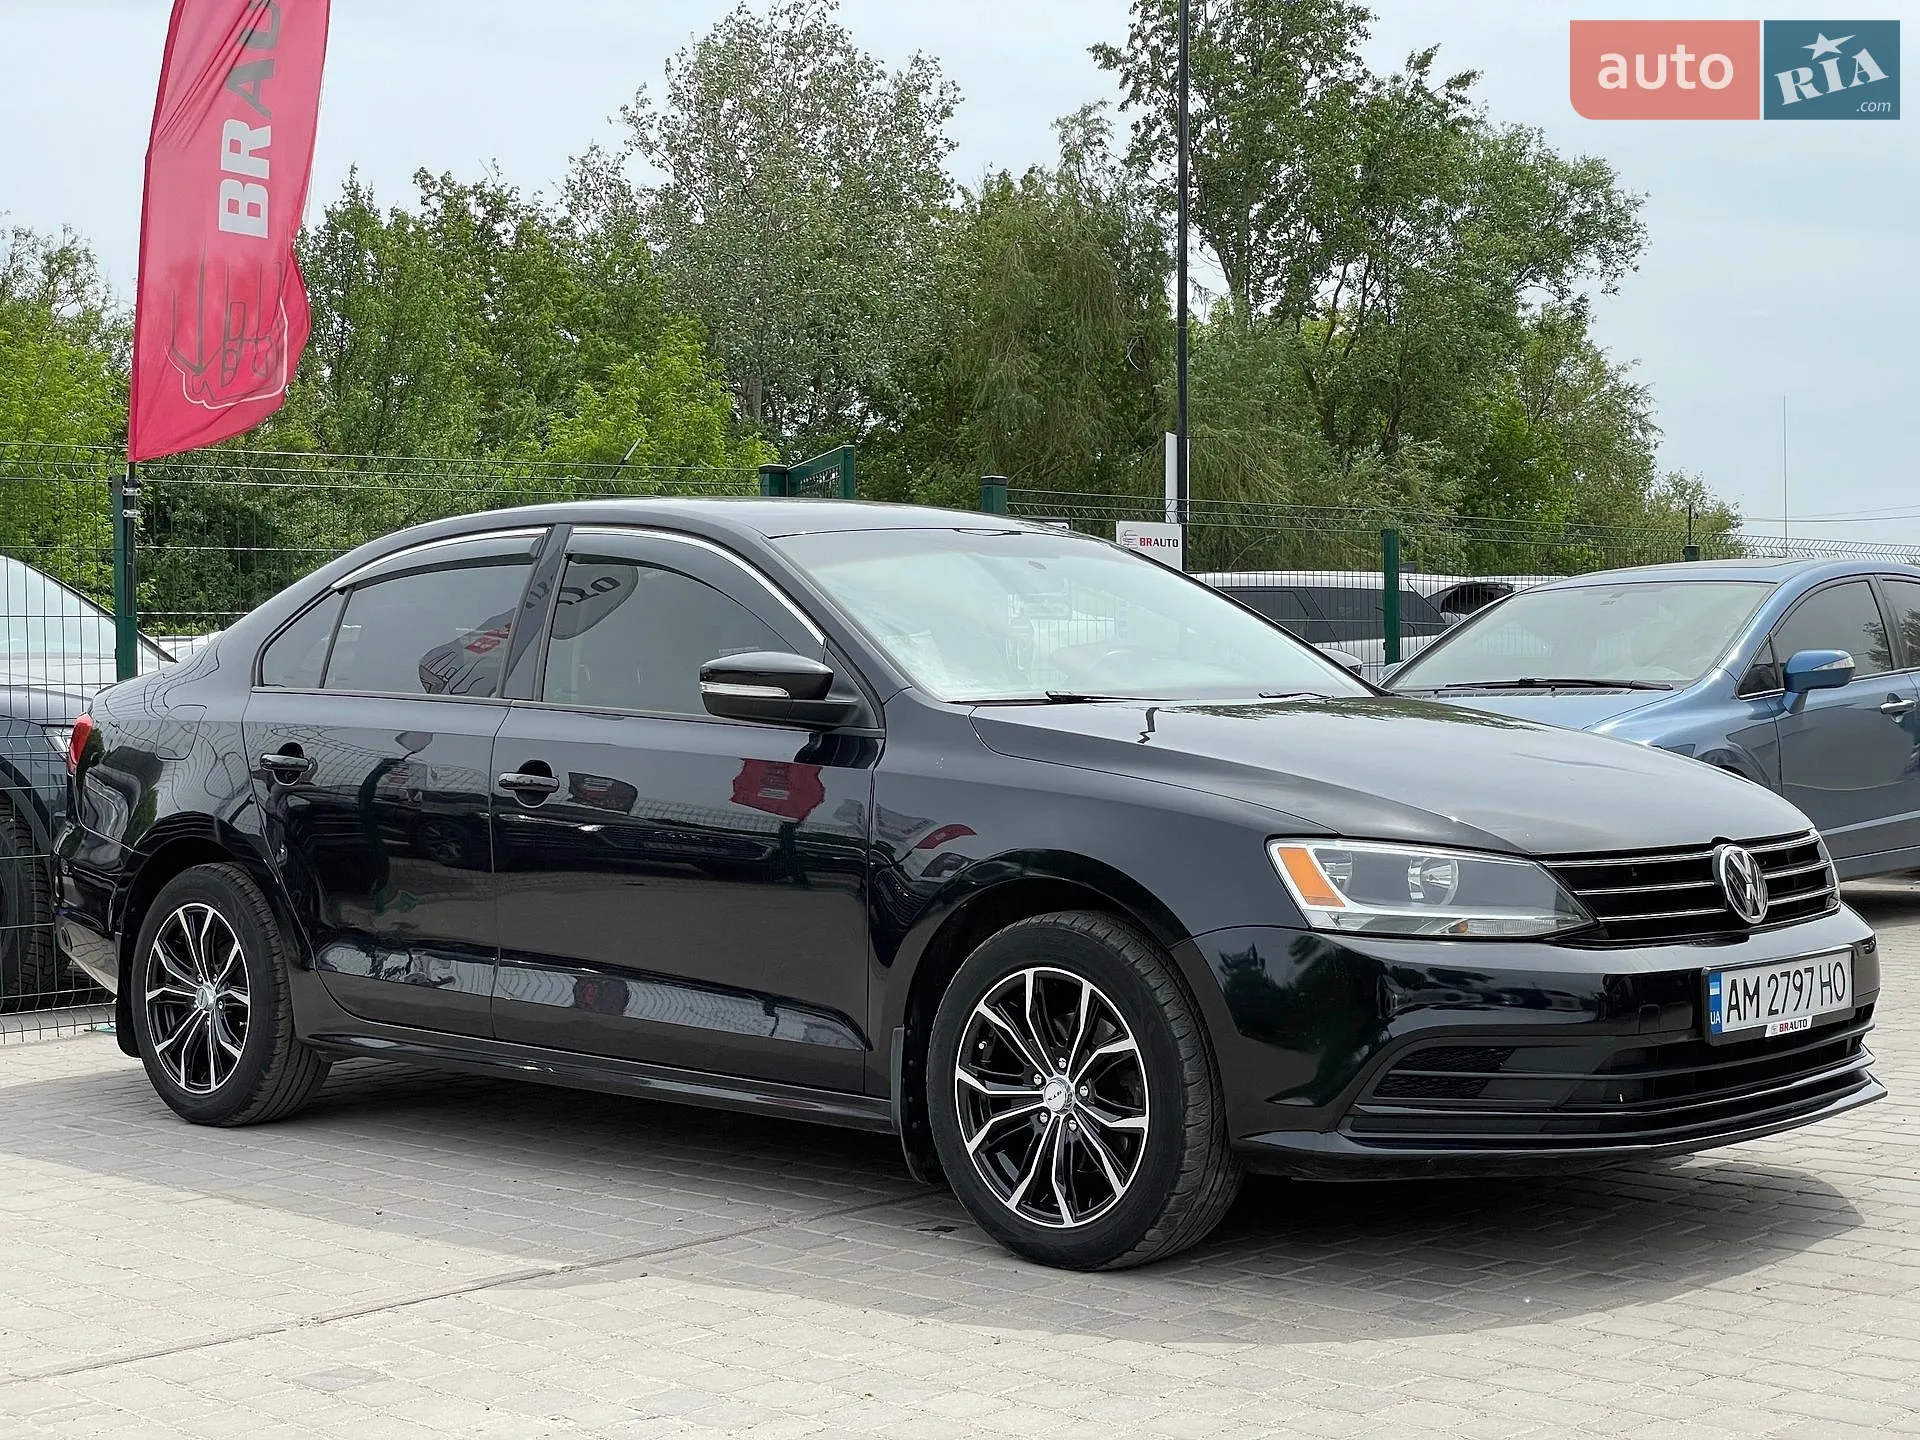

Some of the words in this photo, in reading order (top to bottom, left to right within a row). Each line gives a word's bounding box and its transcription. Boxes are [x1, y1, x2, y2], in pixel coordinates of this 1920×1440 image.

[1139, 537, 1179, 547] BRAUTO
[1726, 975, 1759, 1023] AM
[1767, 967, 1814, 1016] 2797
[1819, 961, 1846, 1006] HO
[1710, 1011, 1721, 1025] UA
[1779, 1019, 1807, 1032] BRAUTO
